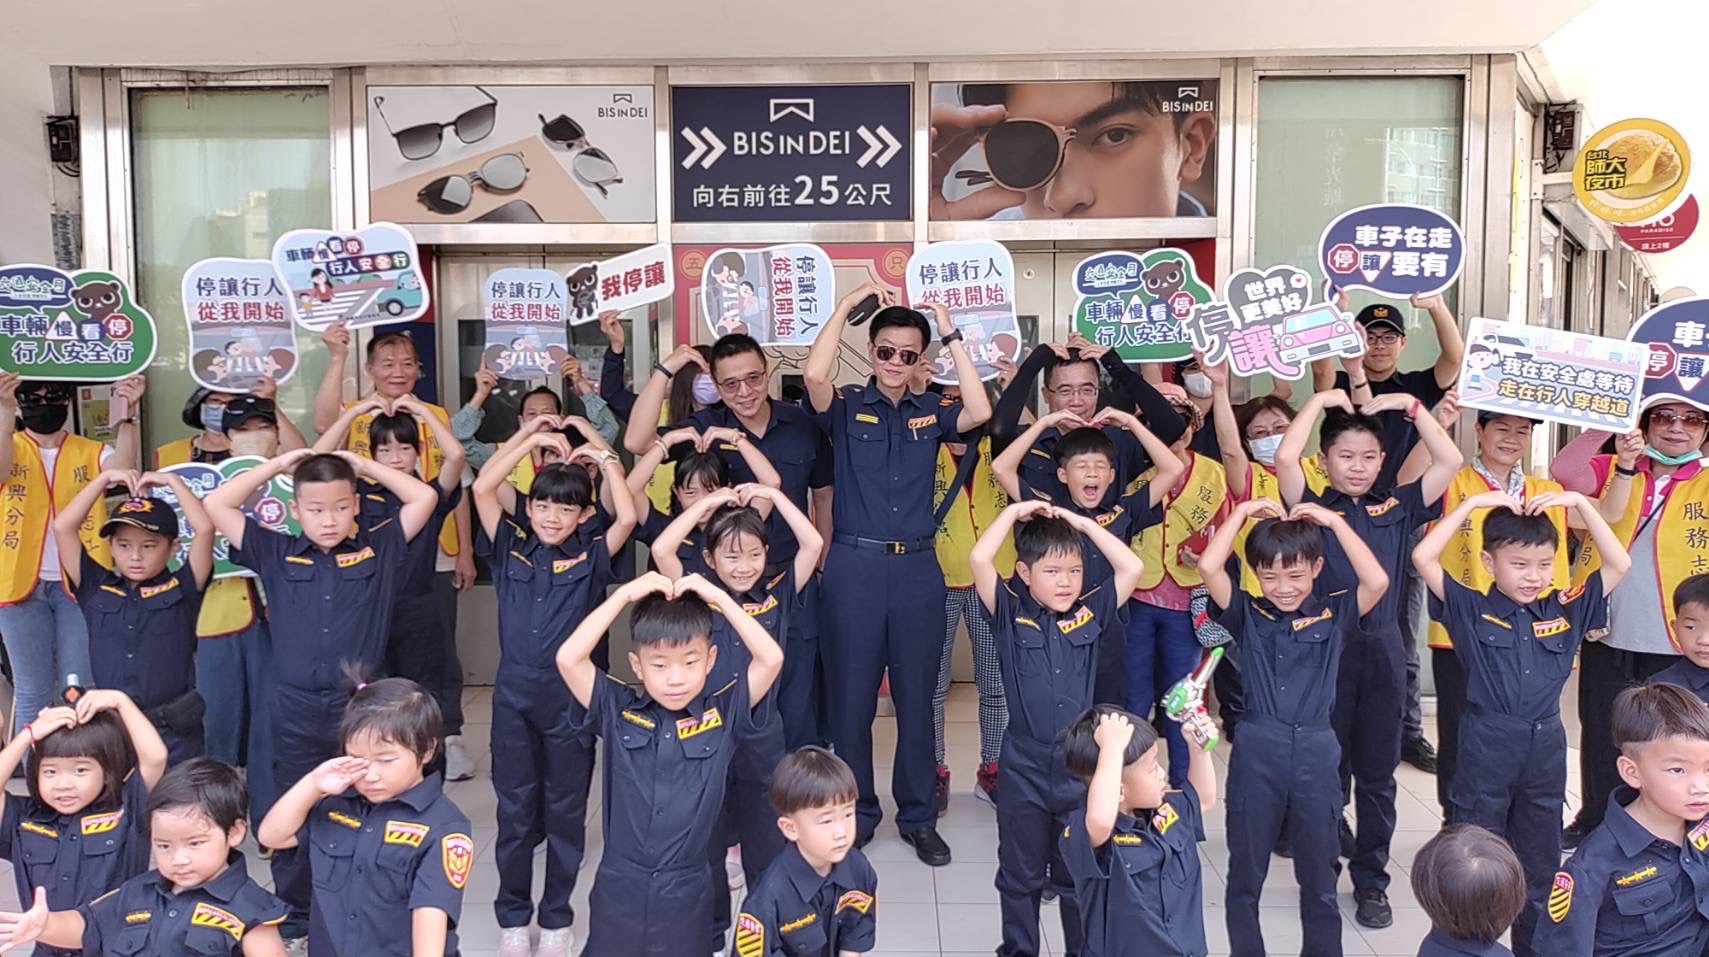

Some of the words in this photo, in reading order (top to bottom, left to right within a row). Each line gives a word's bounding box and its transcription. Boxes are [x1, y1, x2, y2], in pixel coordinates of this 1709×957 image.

[598, 107, 648, 117] BISINDEI
[1163, 101, 1213, 112] BISINDEI
[733, 131, 850, 155] BISINDEI
[1586, 158, 1626, 174] 師大
[693, 175, 893, 208] 向右前往25公尺
[1585, 175, 1625, 189] 夜市
[1355, 225, 1452, 248] 車子在走
[328, 253, 408, 275] 行人安全行
[919, 257, 1003, 286] 停讓行人
[1333, 250, 1449, 277] 停讓要有
[196, 277, 284, 298] 停讓行人
[491, 281, 561, 300] 停讓行人
[601, 260, 665, 300] 我停讓
[1244, 276, 1286, 301] 世界
[772, 256, 796, 337] 從我開始
[796, 255, 820, 335] 停讓行人
[921, 282, 1006, 309] 從我開始
[1240, 293, 1302, 323] 更美好
[198, 302, 285, 322] 從我開始
[491, 302, 561, 321] 從我開始
[1185, 303, 1300, 376] 停讓
[1672, 320, 1709, 348] 車
[12, 341, 133, 363] 行人安全行
[1502, 357, 1635, 394] 我在安全處等待
[1498, 379, 1629, 417] 走在行人穿越道
[3, 463, 30, 550] 新興分局
